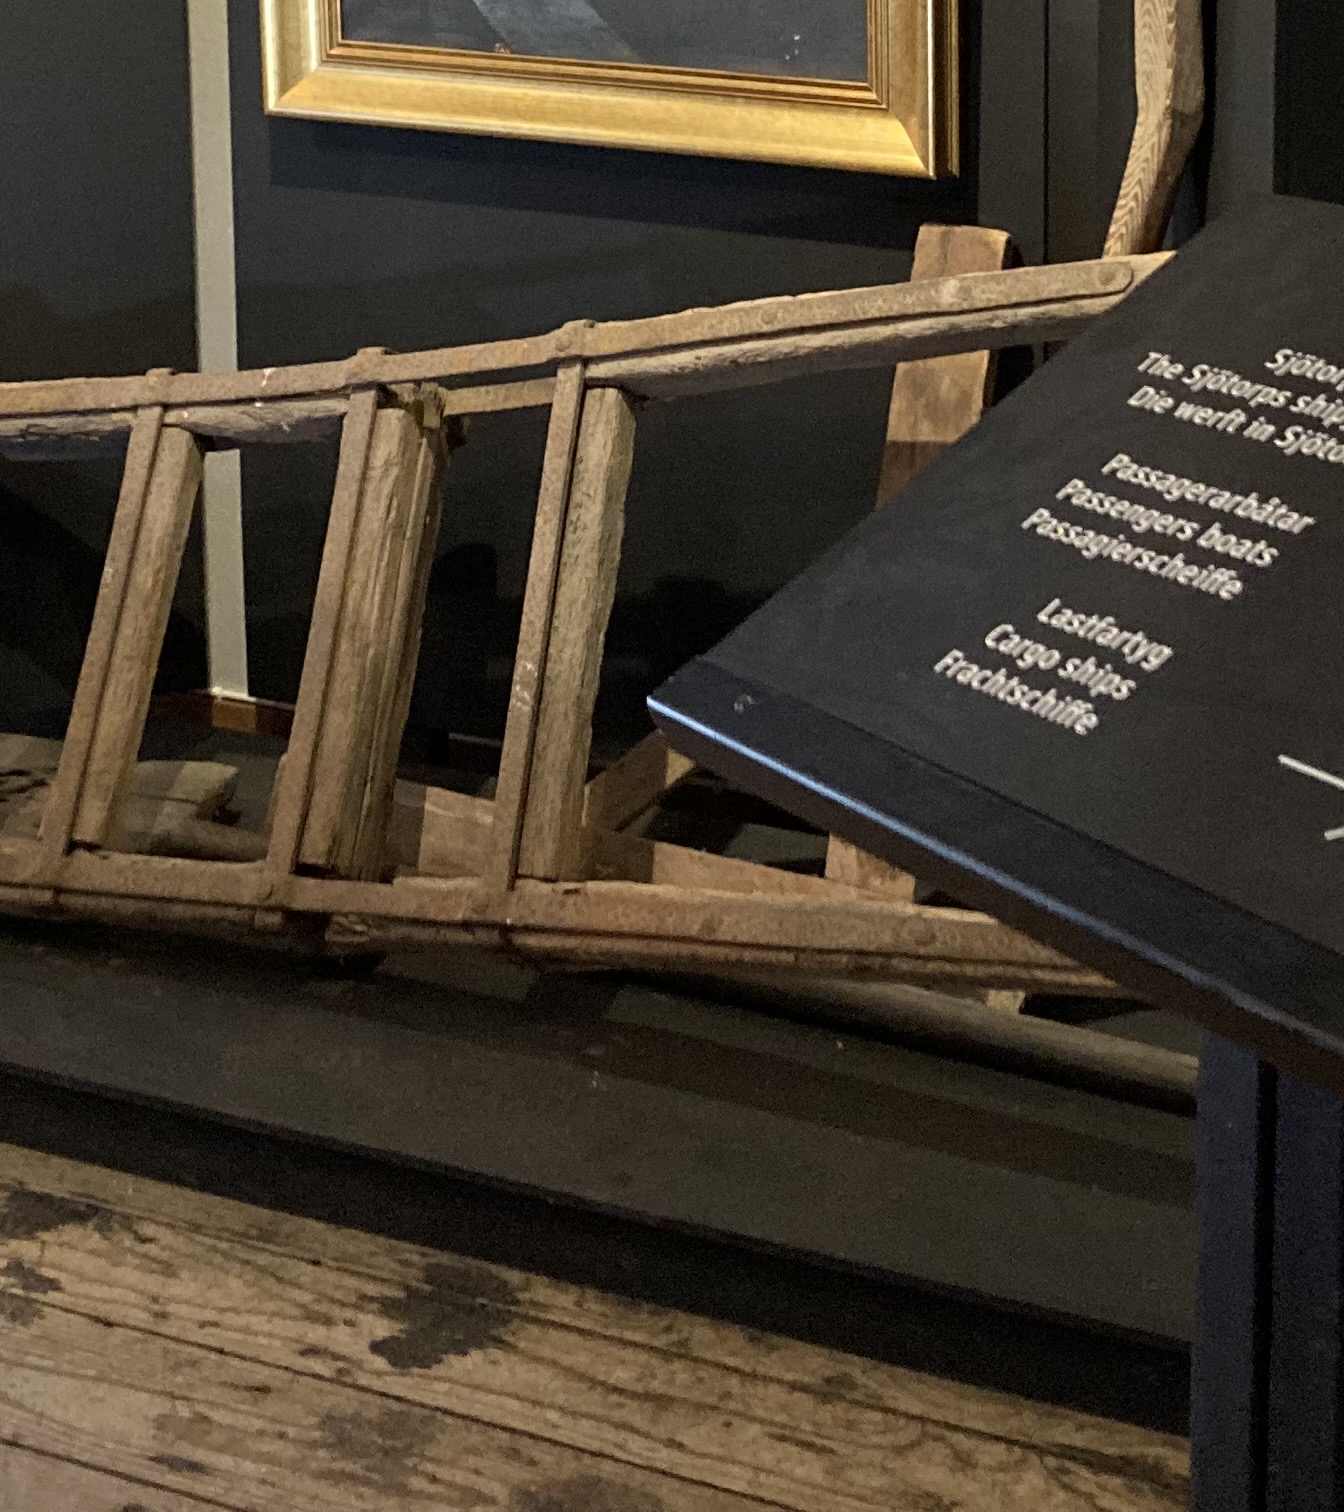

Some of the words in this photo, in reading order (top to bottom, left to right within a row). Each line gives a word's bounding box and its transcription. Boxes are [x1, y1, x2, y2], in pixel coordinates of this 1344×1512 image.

[1127, 385, 1174, 414] Die
[1173, 398, 1247, 434] werft
[1243, 416, 1277, 443] in
[1137, 351, 1184, 381] The
[1181, 363, 1292, 409] Sjötorps
[1055, 478, 1200, 541] Passengers
[1196, 522, 1280, 568] boats
[1101, 453, 1316, 535] Passagerarbåtar
[984, 624, 1061, 669] Cargo
[1057, 655, 1137, 701] ships
[1036, 598, 1175, 671] Lastfartyg
[933, 649, 1100, 736] Frachtschiffe
